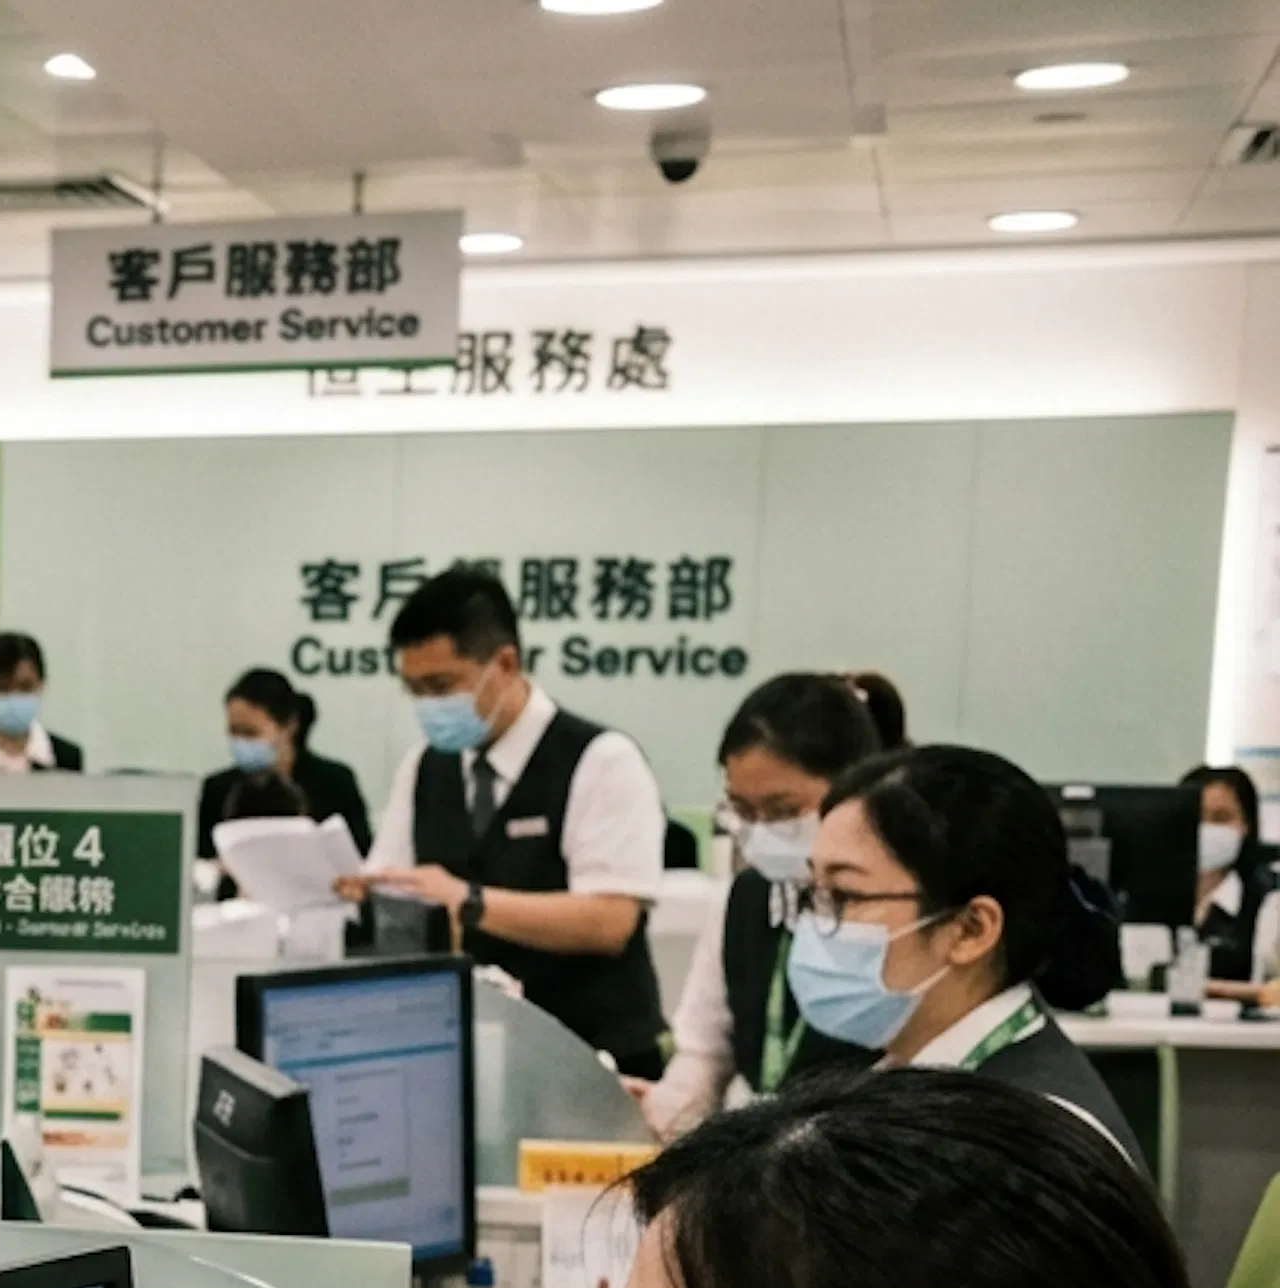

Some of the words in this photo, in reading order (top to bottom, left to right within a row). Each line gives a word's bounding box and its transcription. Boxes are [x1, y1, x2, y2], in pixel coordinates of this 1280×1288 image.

[107, 238, 403, 303] 客戶服務部
[85, 314, 267, 348] Customer
[278, 307, 421, 342] Service
[300, 556, 734, 621] 客戶服務部
[291, 636, 546, 677] Custr
[561, 635, 749, 677] Service
[72, 825, 105, 868] 4
